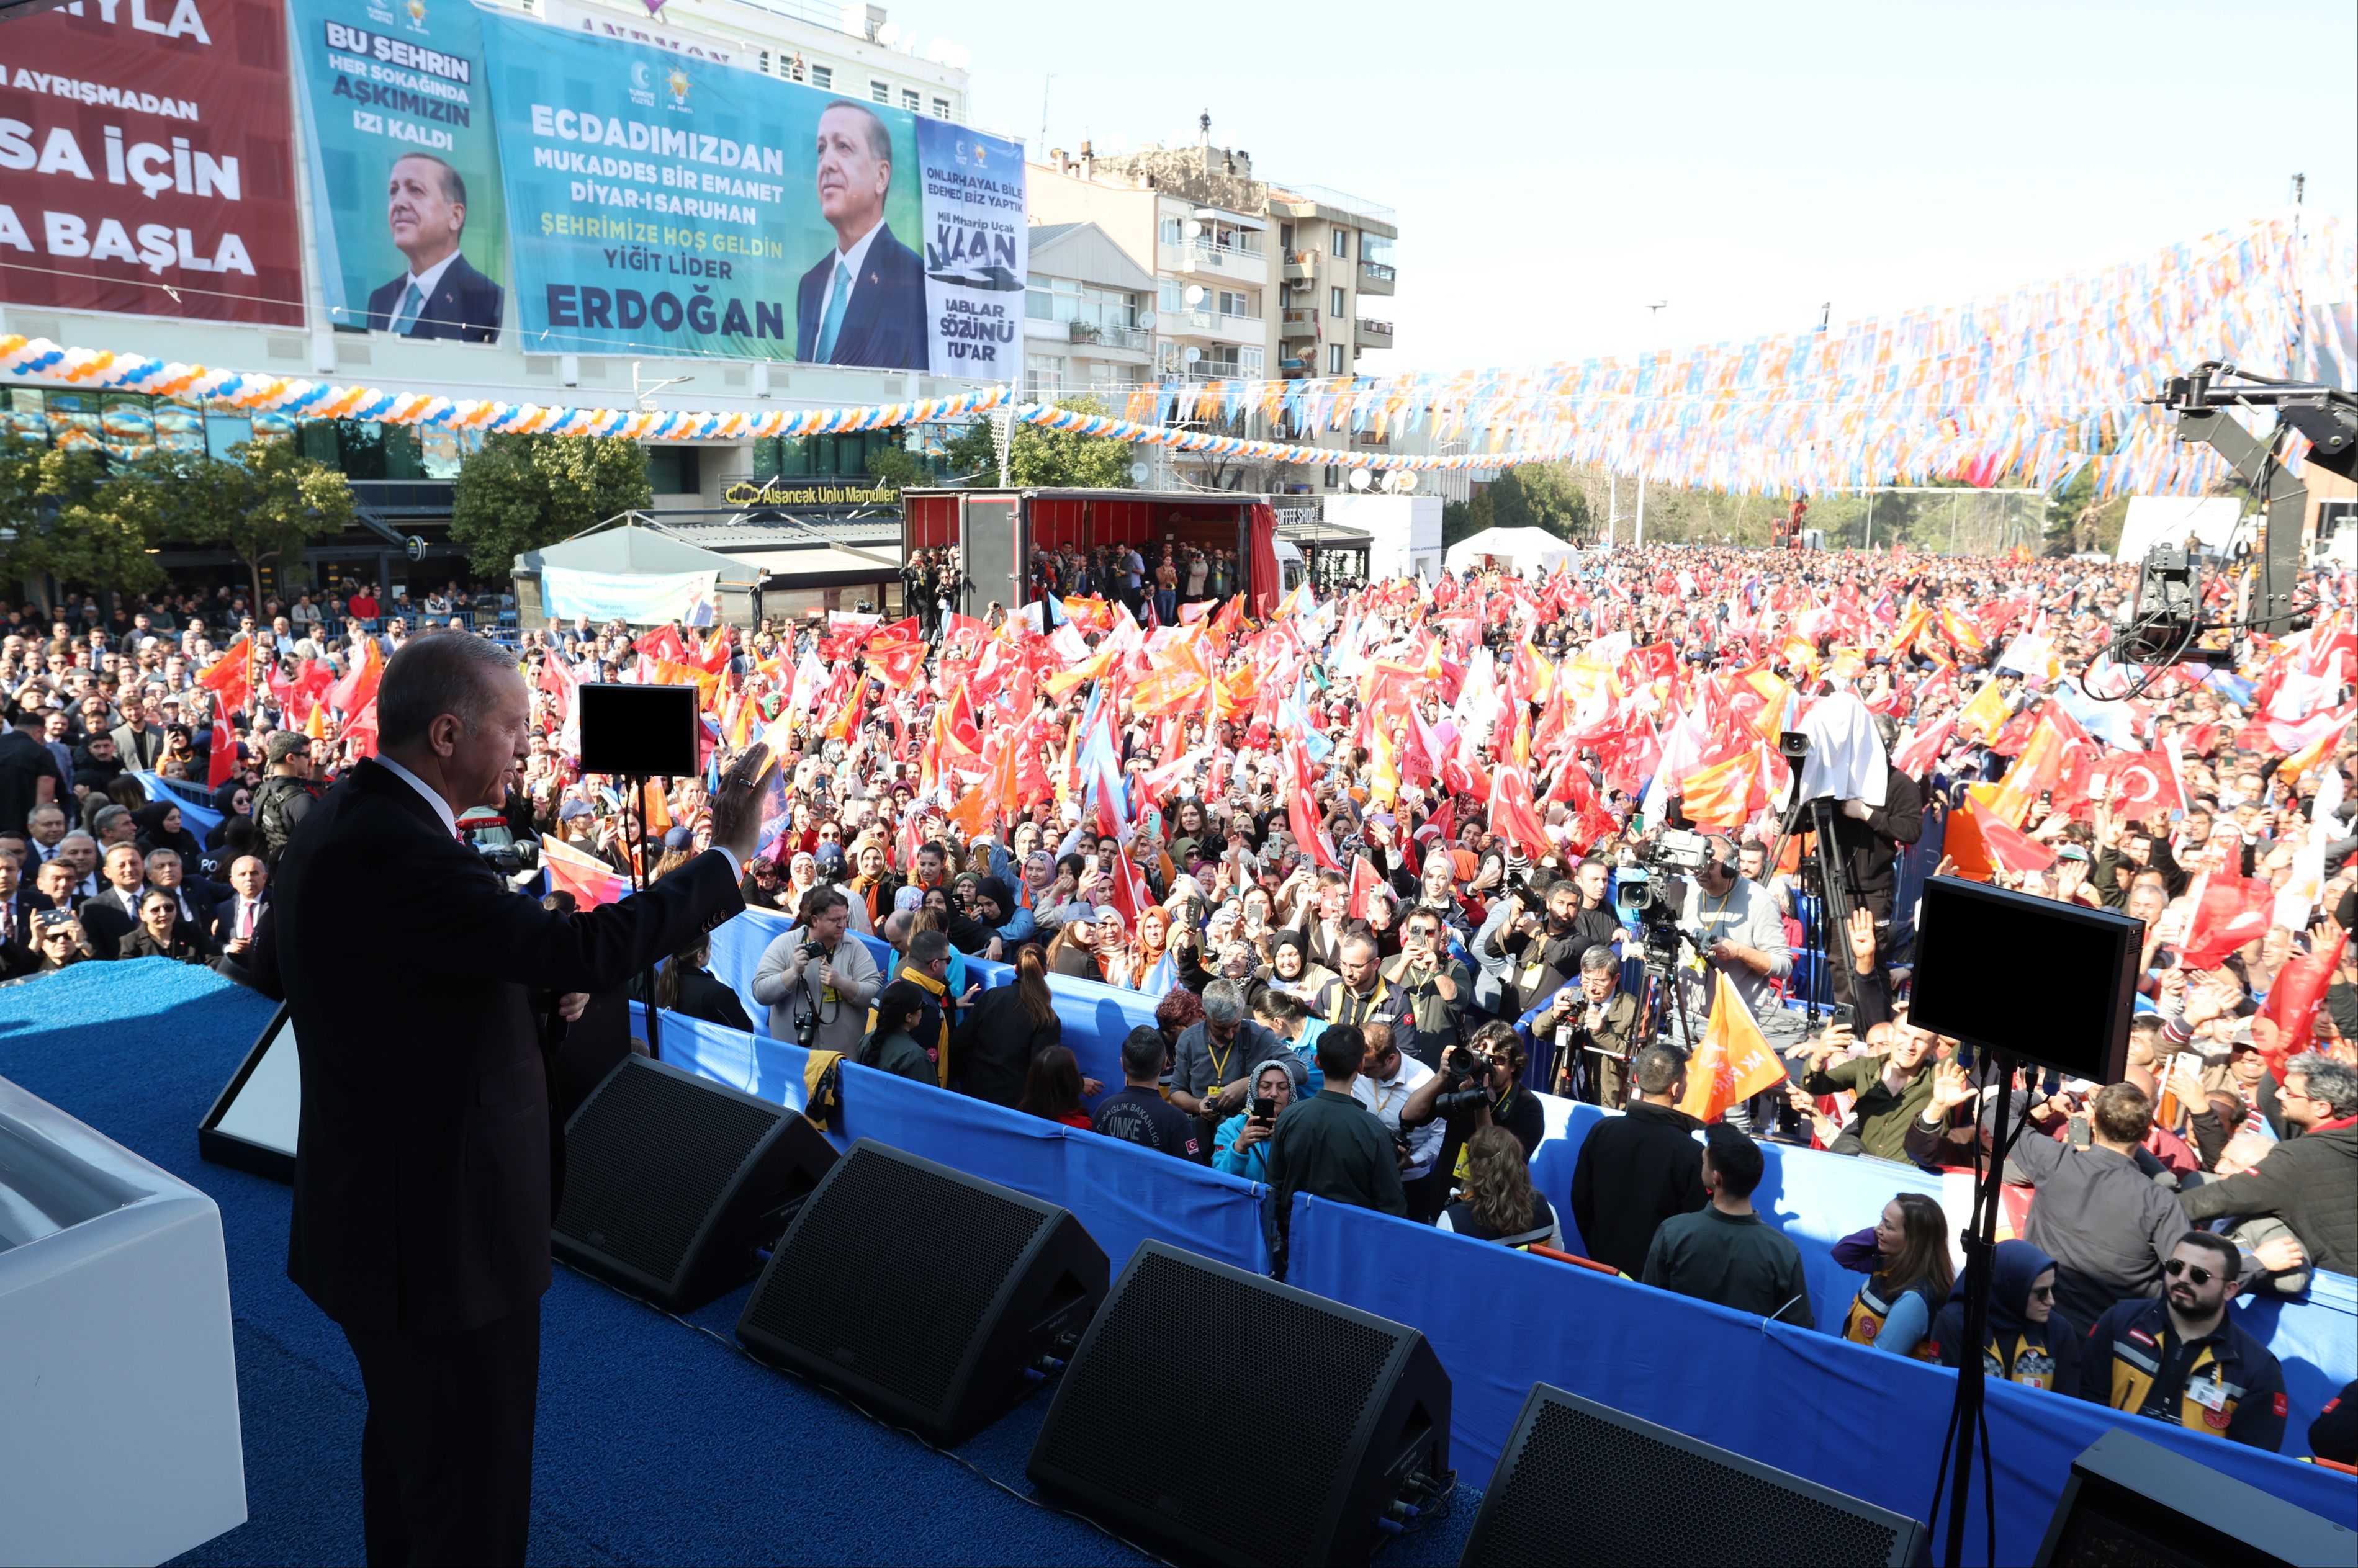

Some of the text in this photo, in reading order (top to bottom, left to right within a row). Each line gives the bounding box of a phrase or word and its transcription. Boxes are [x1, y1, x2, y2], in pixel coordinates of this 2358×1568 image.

[326, 22, 469, 82] BU ŞEHRİN
[12, 68, 199, 122] AYRIŞMADAN
[328, 54, 469, 104] HER SOKAĞINDA
[333, 75, 470, 128] AŞKIMIZIN
[353, 110, 453, 151] İZİ KALDI
[531, 104, 783, 176] ECDADIMIZDAN
[104, 125, 241, 200] İÇİN
[534, 146, 783, 203] MUKADDES BİR EMANET
[965, 190, 986, 204] BİZ
[988, 195, 1024, 213] YAPTIK
[1002, 182, 1023, 199] BİLE
[43, 211, 256, 275] BAŞLA
[541, 212, 783, 259] ŞEHRİMİZE HOŞ GELDİN
[991, 221, 1015, 233] Uçak
[604, 246, 732, 279] YİĞİT LİDER
[546, 284, 784, 340] ERDOĞAN
[763, 486, 817, 504] Alsancak
[1297, 508, 1315, 524] SHOP
[1102, 1103, 1130, 1122] SAĞLIK
[1109, 1116, 1142, 1141] UMKE
